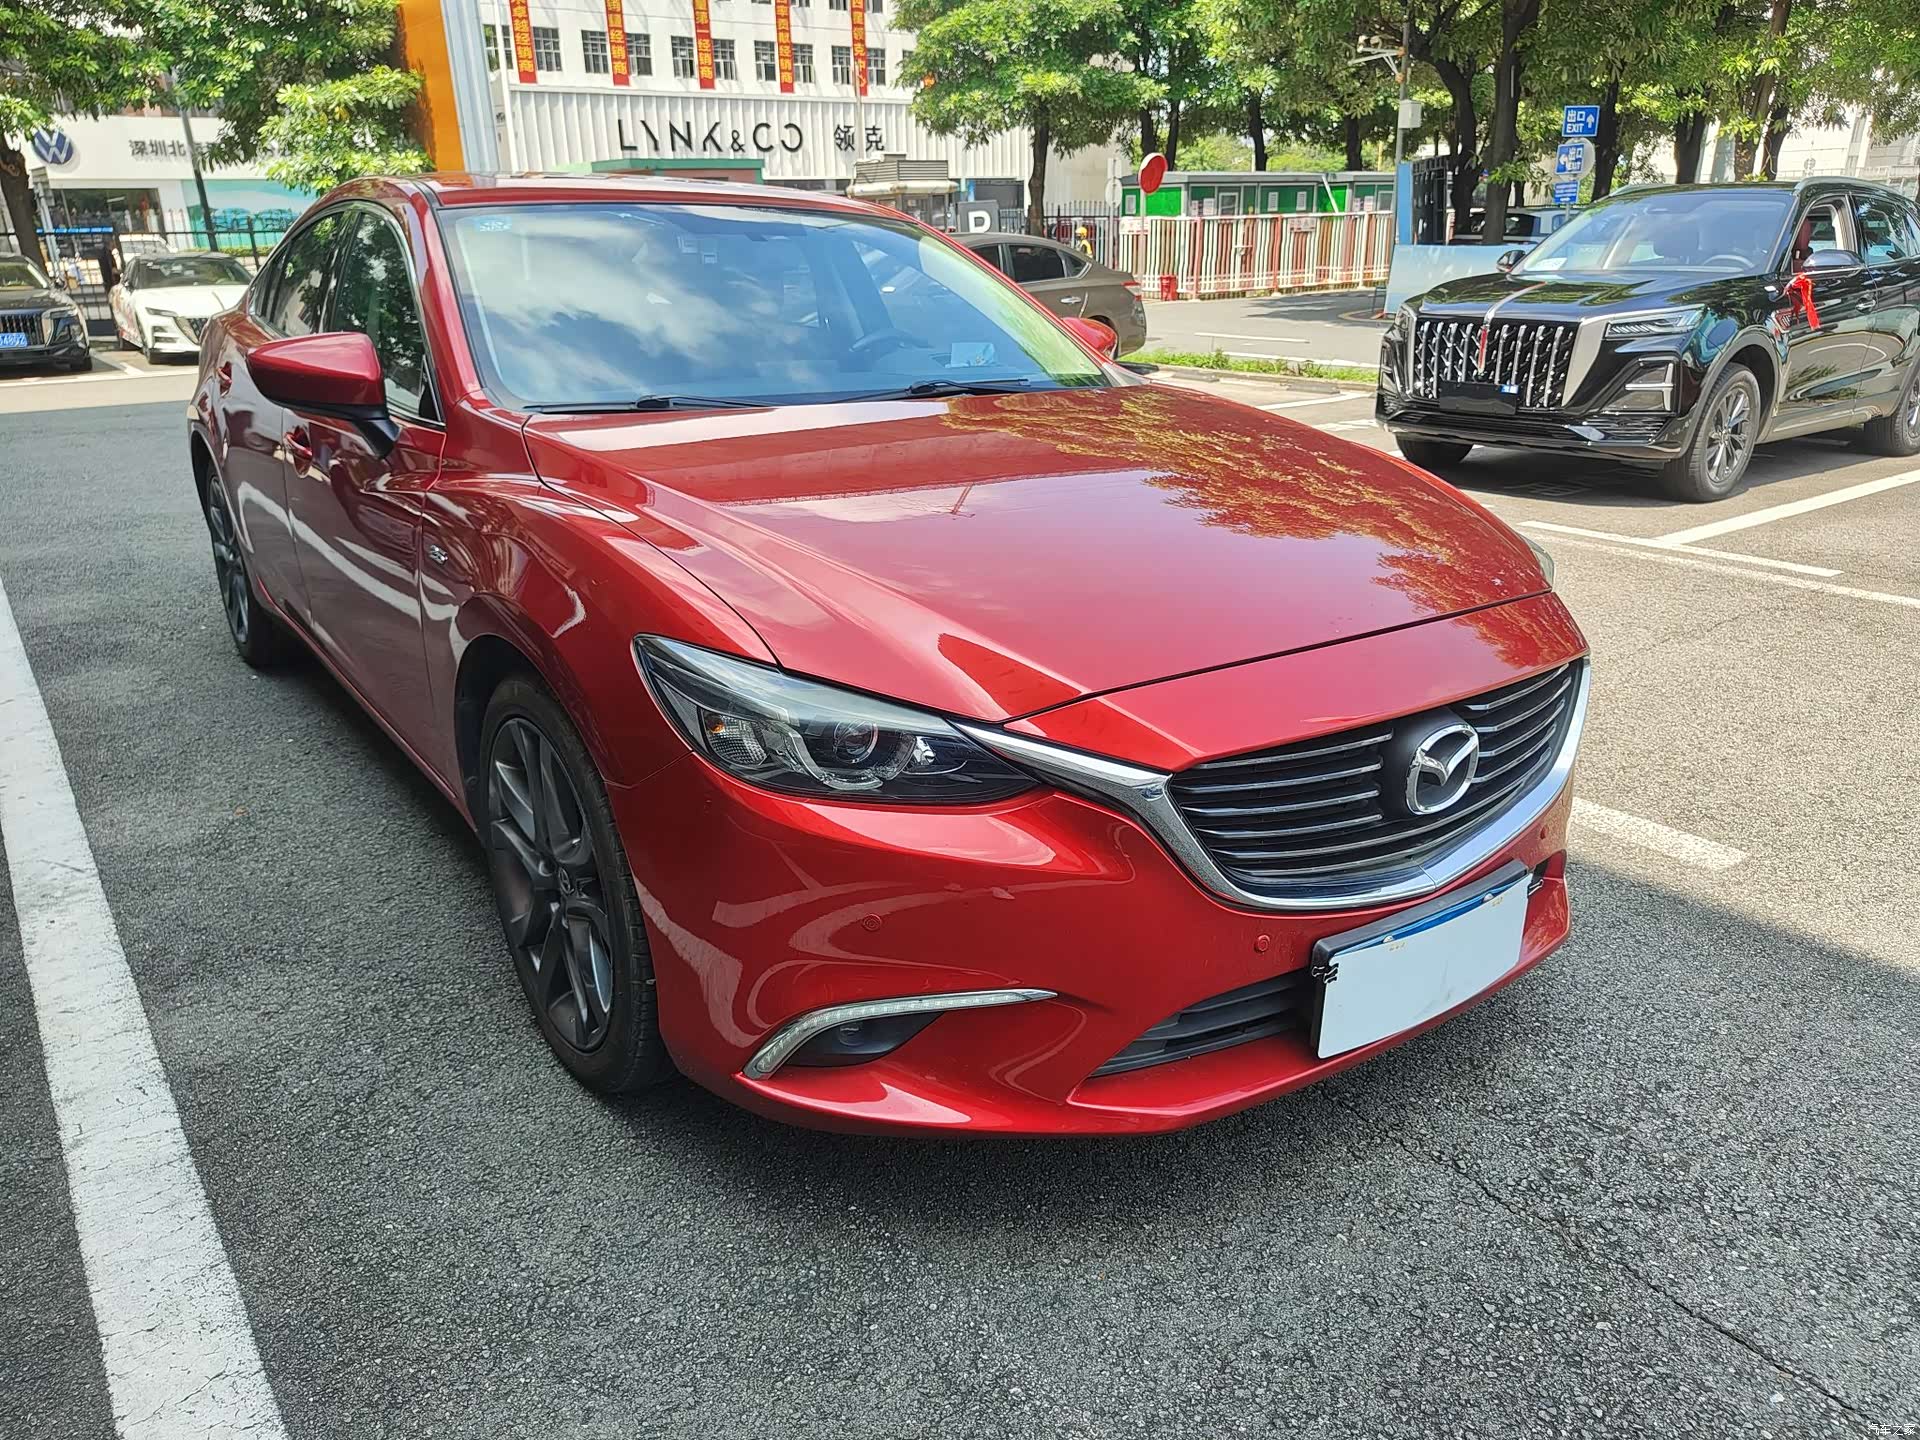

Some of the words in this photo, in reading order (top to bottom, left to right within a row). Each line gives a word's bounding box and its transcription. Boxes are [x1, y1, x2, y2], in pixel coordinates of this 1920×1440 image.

[617, 119, 803, 153] LYNK&CO
[833, 123, 885, 152] 领克
[1566, 123, 1584, 133] EXIT
